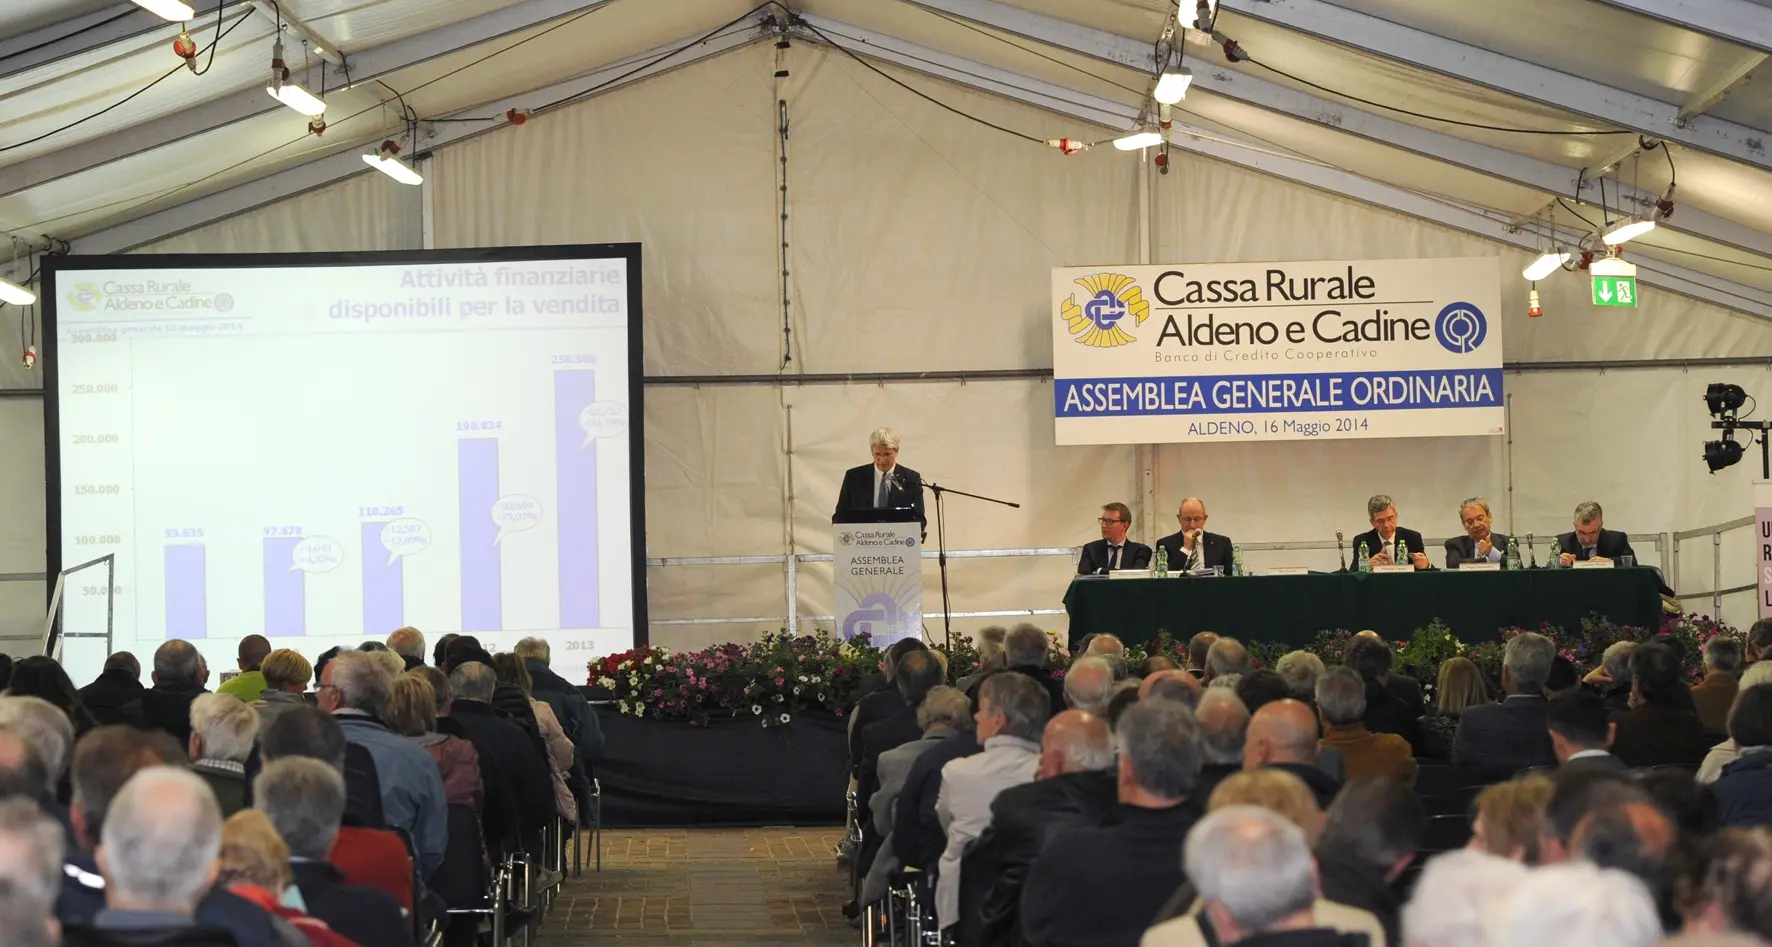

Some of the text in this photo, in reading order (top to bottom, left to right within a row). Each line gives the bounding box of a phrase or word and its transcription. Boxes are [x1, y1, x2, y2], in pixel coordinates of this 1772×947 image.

[400, 265, 621, 289] Attività finanziarie
[103, 279, 191, 295] Cassa Rurale
[1153, 265, 1376, 305] Cassa Rurale
[104, 296, 213, 311] Aldeno e Cadine
[328, 295, 620, 323] disponibili per la vendita
[1156, 310, 1431, 347] Aldeno e Cadine
[71, 334, 117, 344] 300.000
[1155, 347, 1377, 363] Banca di Credito Cooperativo
[72, 384, 118, 395] 250.000
[1064, 374, 1494, 412] ASSEMBLEA GENERALE ORDINARIA
[1188, 418, 1369, 436] ALDENO, 16 Maggio 2014
[73, 434, 119, 444] 200.000
[74, 485, 120, 495] 150.000
[358, 506, 404, 517] 110.265
[164, 528, 204, 538] 93.635
[75, 535, 121, 545] 100.000
[850, 556, 905, 565] ASSEMBLEA
[850, 567, 905, 576] GENERALE
[82, 585, 122, 596] 50.00
[566, 641, 595, 651] 2013
